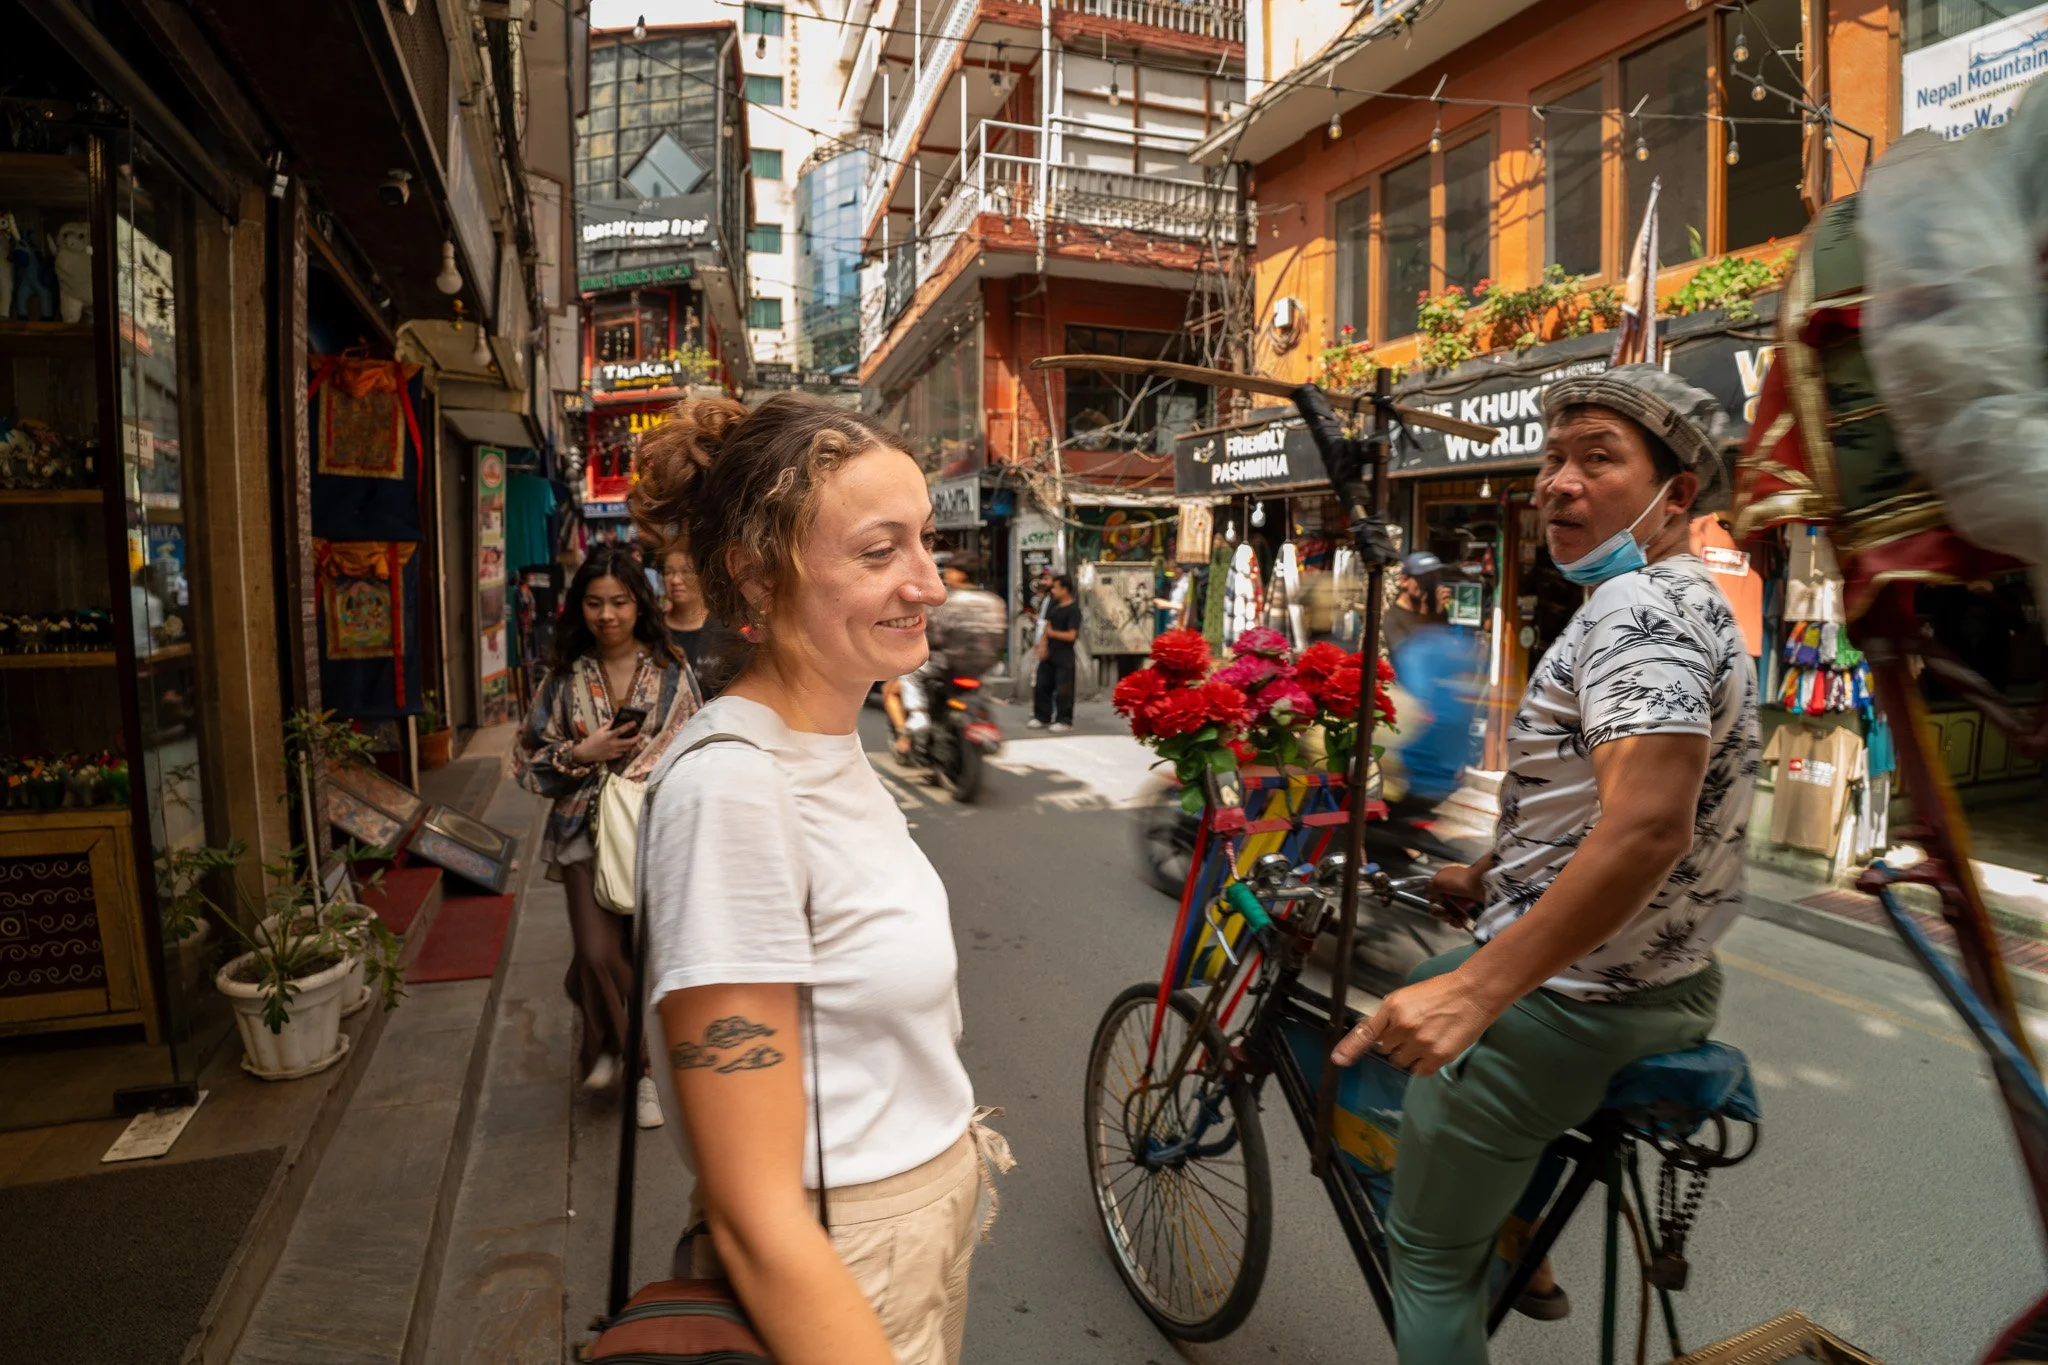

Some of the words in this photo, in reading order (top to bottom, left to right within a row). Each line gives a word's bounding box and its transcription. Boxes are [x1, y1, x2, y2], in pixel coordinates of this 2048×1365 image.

[1917, 74, 1962, 109] Nepal
[1967, 45, 2048, 92] Mountain
[603, 359, 681, 379] Thakai
[1225, 427, 1287, 457] FRIENDLY
[1211, 454, 1289, 484] PASHMINA
